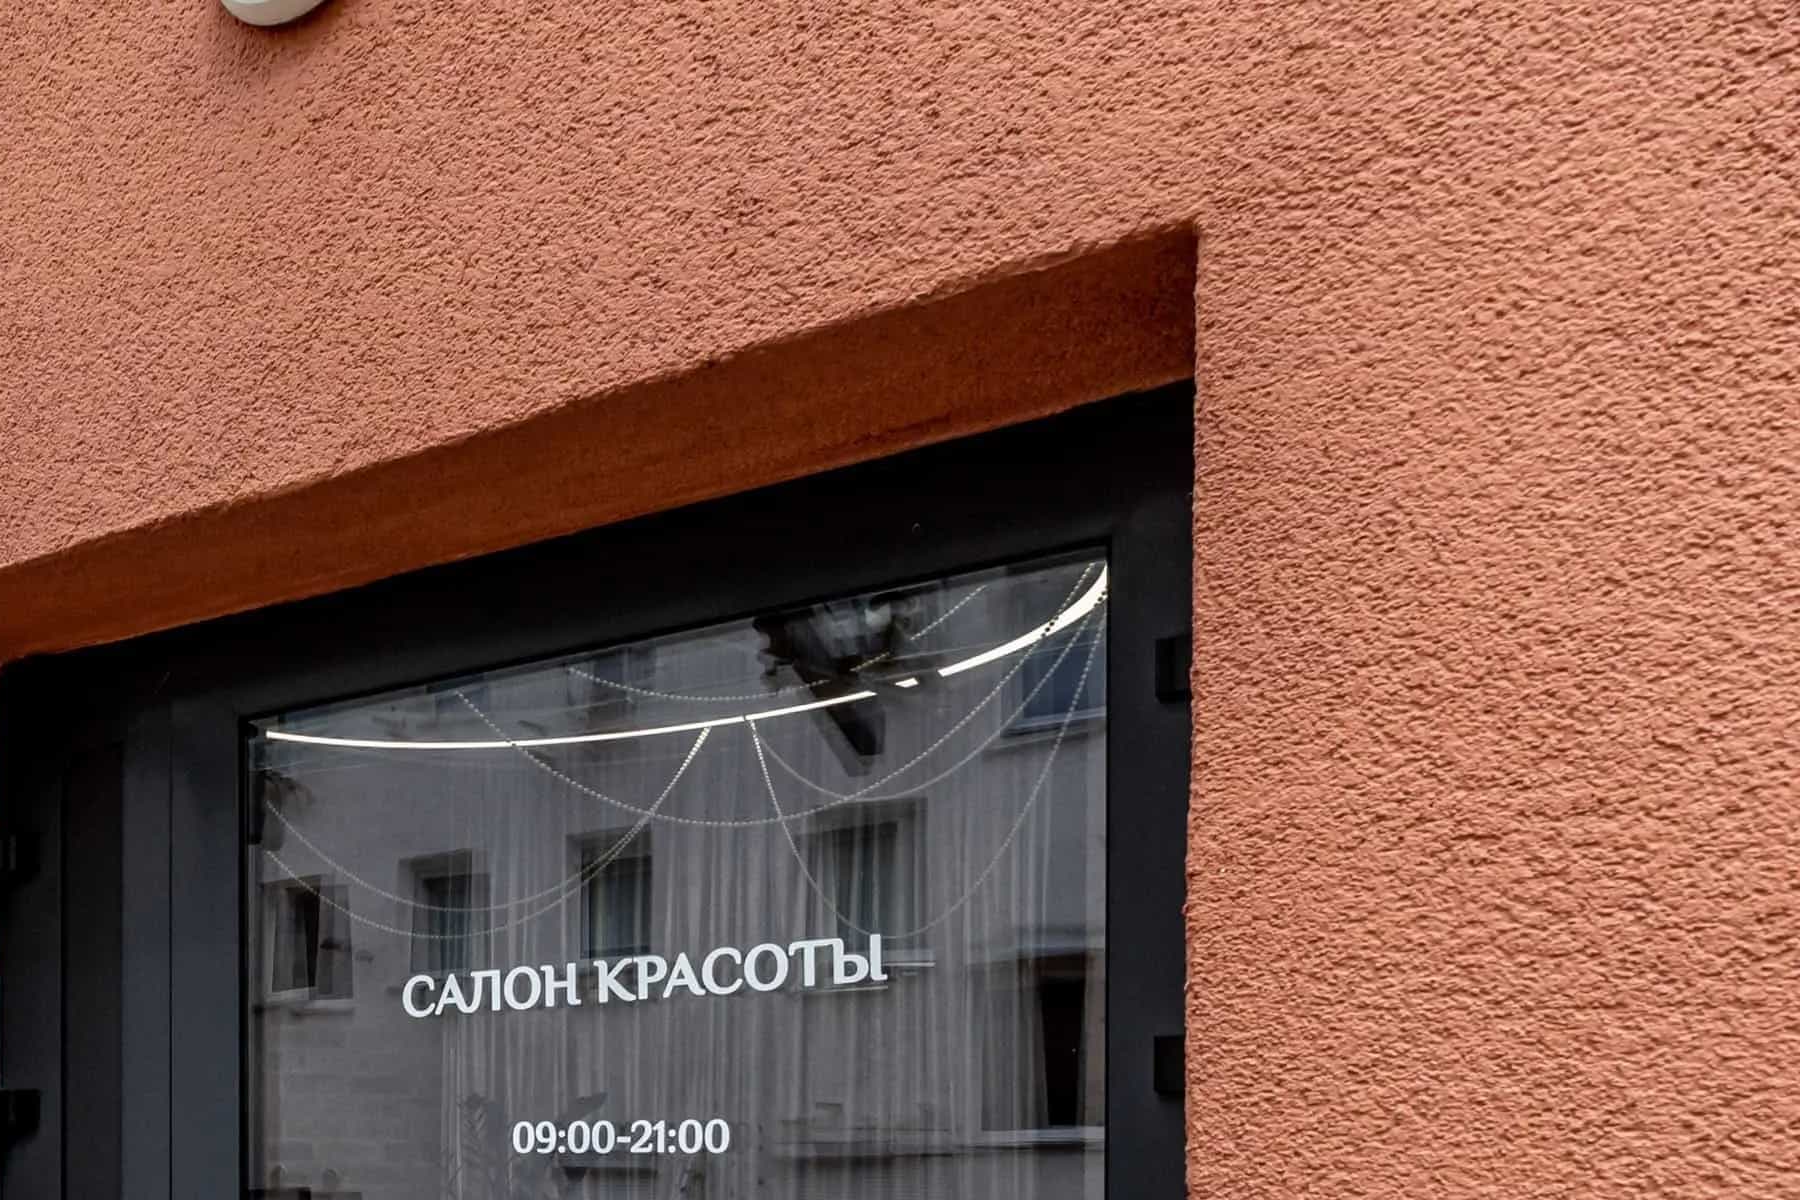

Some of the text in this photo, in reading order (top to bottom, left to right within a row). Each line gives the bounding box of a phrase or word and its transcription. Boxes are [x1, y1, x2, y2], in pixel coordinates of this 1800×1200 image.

[402, 934, 888, 1018] САЛОН КРАСОТЫ
[512, 1118, 730, 1154] 09:00-21:00
